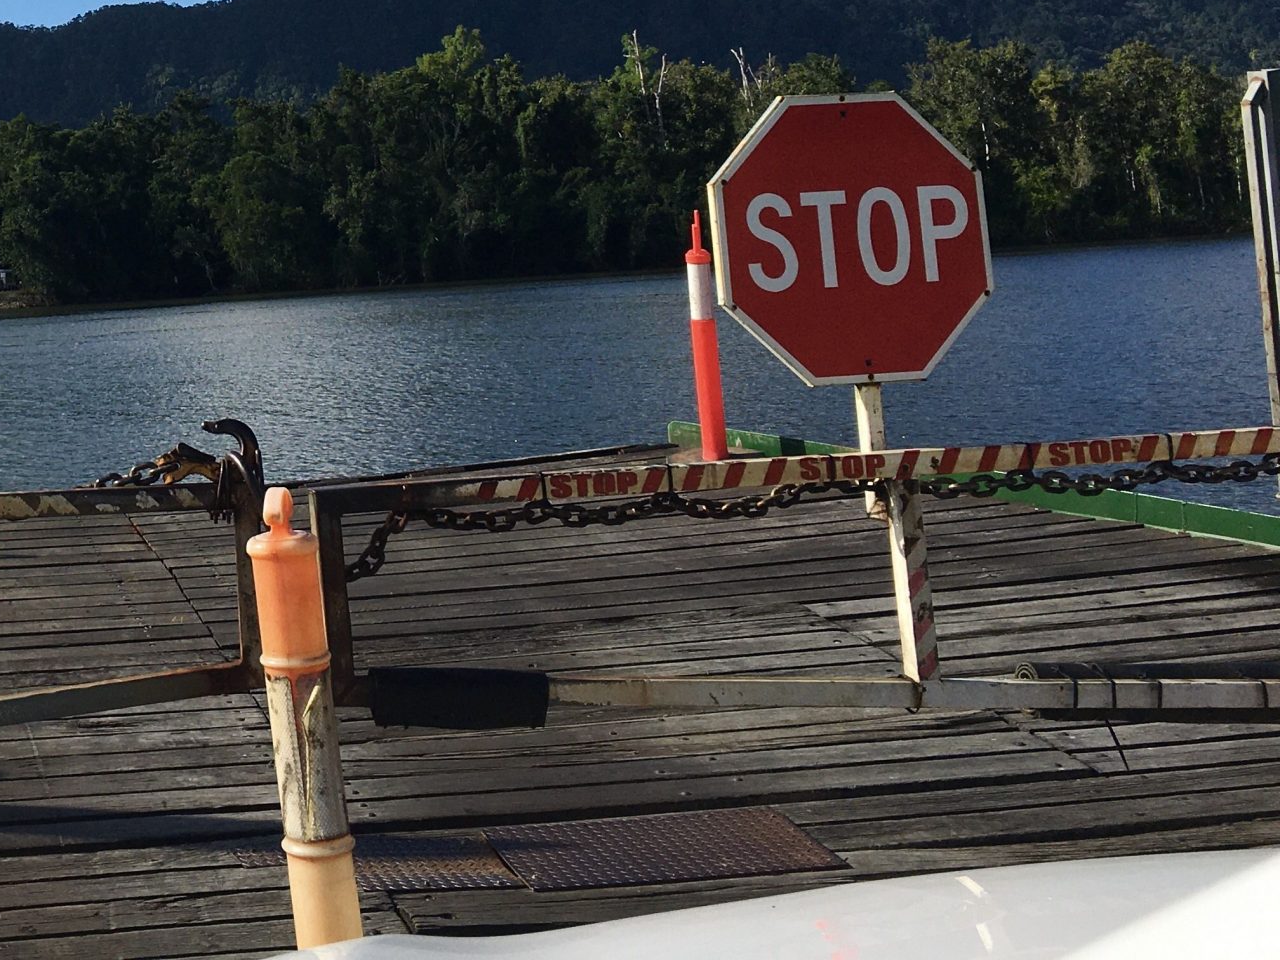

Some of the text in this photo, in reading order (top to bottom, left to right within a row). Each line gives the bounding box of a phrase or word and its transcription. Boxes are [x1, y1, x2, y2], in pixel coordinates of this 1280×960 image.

[746, 185, 969, 293] STOP
[1048, 439, 1132, 467] STOP
[799, 454, 886, 480] STOP
[550, 471, 638, 498] STOP
